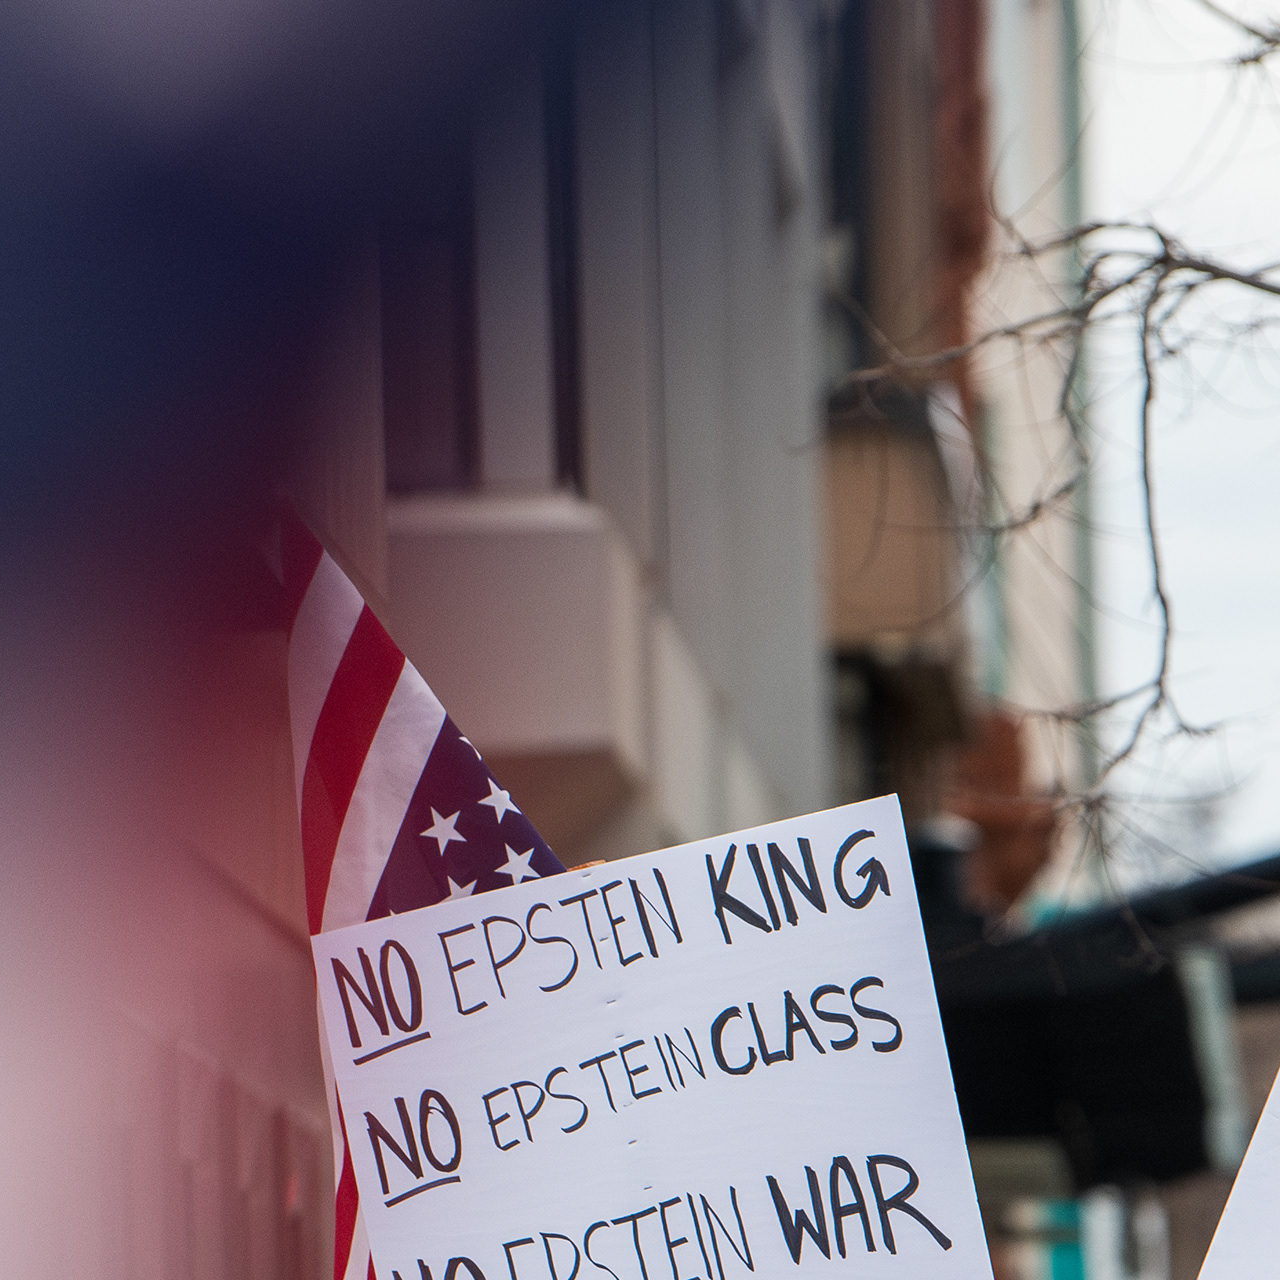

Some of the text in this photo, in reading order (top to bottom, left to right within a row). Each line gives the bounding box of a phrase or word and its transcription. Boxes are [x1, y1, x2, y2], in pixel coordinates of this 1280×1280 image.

[330, 829, 891, 1048] NO EPSTEN KING
[364, 976, 903, 1195] NO EPSTEIN CLASS
[767, 1155, 952, 1266] WAR
